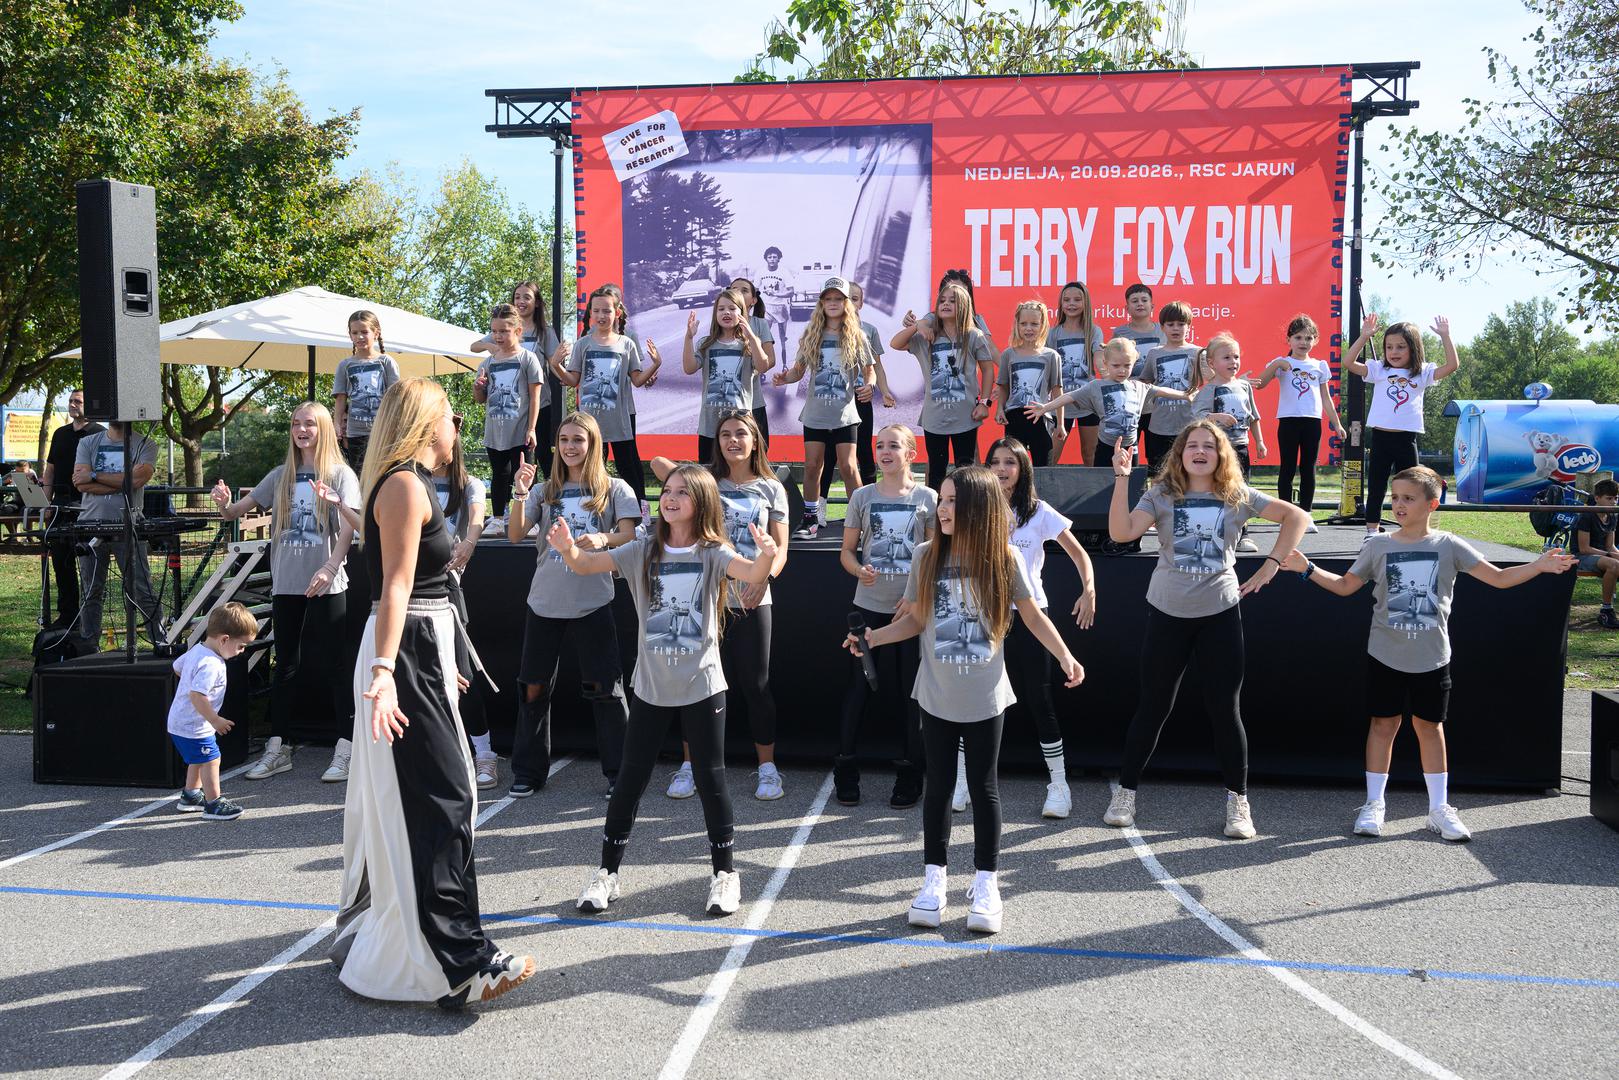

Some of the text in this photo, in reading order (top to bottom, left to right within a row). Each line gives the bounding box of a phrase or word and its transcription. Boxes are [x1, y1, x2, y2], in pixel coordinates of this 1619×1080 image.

[620, 122, 666, 147] GIVE FOR
[628, 135, 666, 155] CANCER
[625, 145, 675, 171] RESEARCH
[964, 161, 1295, 182] NEDJELJA, 20.09.2026., RSC JARUN
[964, 204, 1293, 288] TERRY FOX RUN
[283, 540, 316, 548] FINISH
[294, 548, 303, 556] IT
[874, 566, 908, 574] FINISH
[1179, 565, 1217, 574] FINISH
[1393, 622, 1430, 631] FINISH
[1408, 632, 1418, 640] IT
[653, 646, 694, 656] FINISH
[667, 657, 678, 666] IT
[941, 655, 985, 664] FINISH
[958, 665, 970, 675] IT
